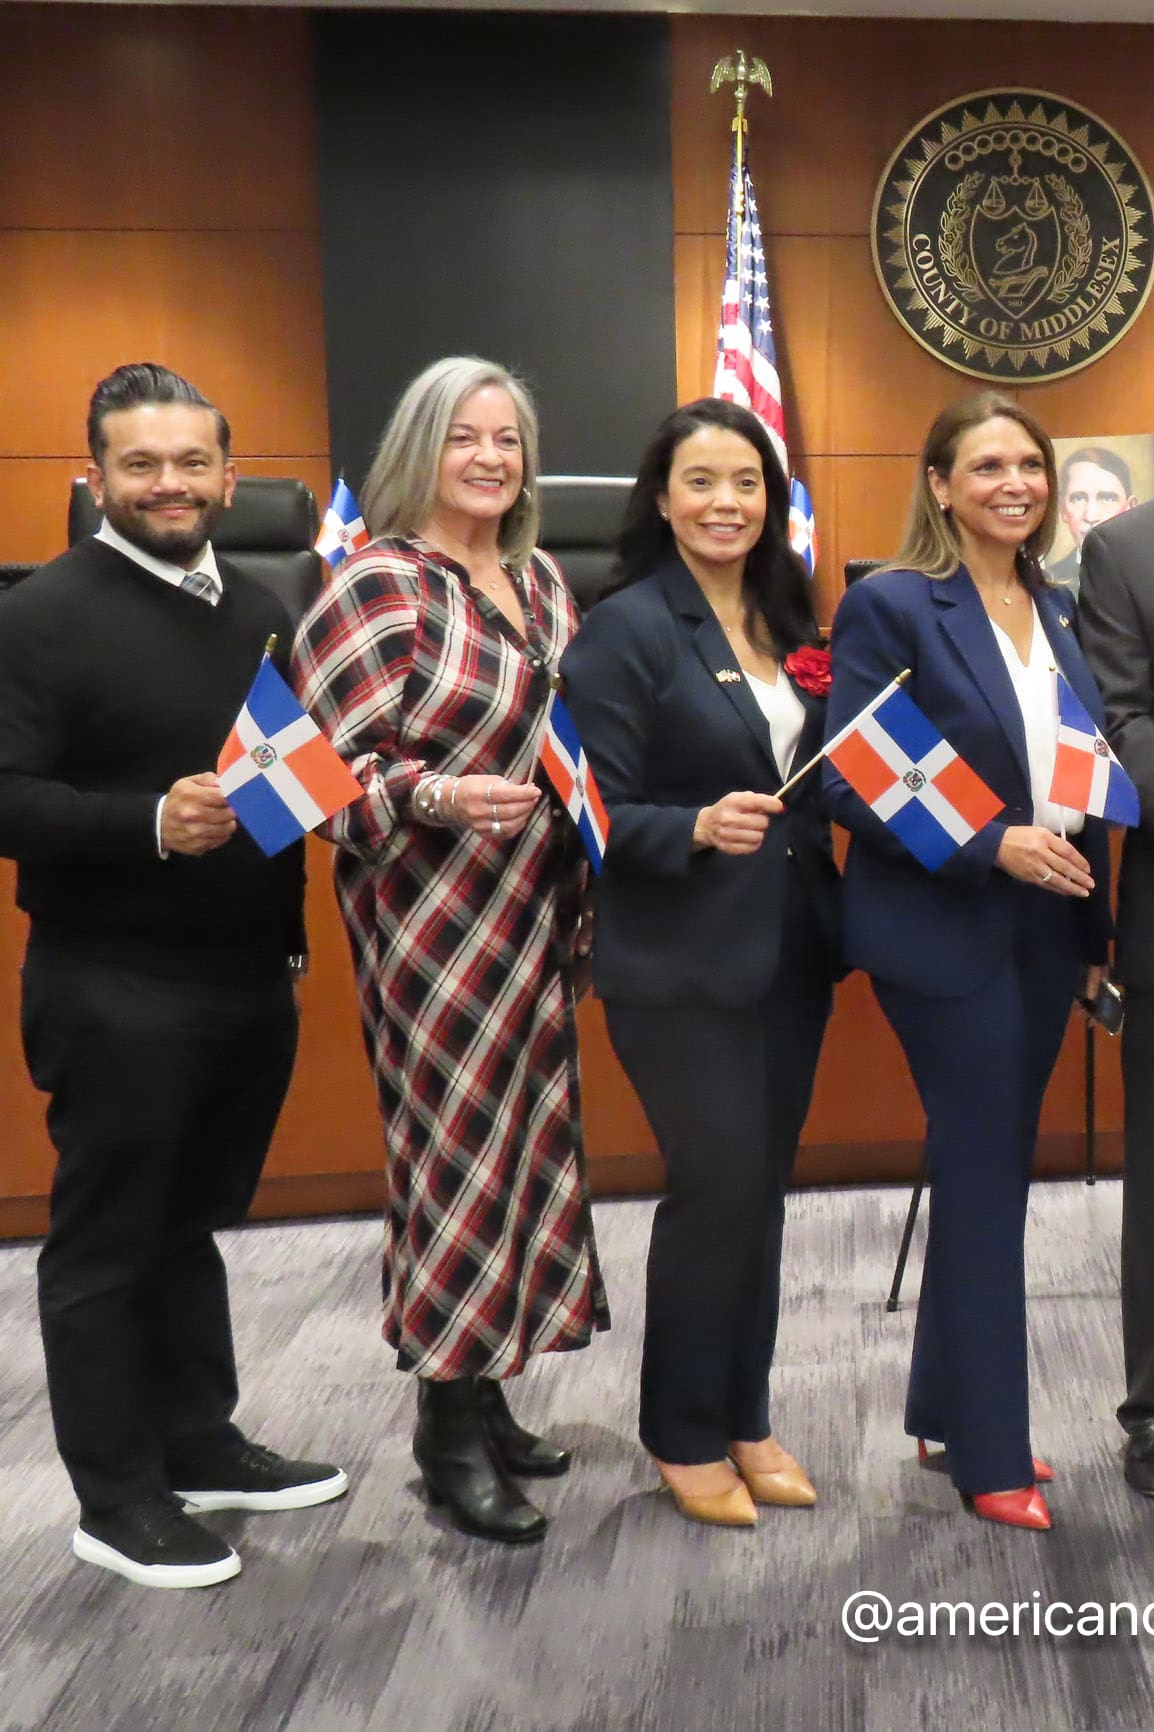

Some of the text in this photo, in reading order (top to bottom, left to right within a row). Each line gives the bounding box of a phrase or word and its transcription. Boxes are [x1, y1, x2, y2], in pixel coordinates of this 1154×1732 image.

[912, 232, 1121, 340] COUNTY OF MIDDLESEX
